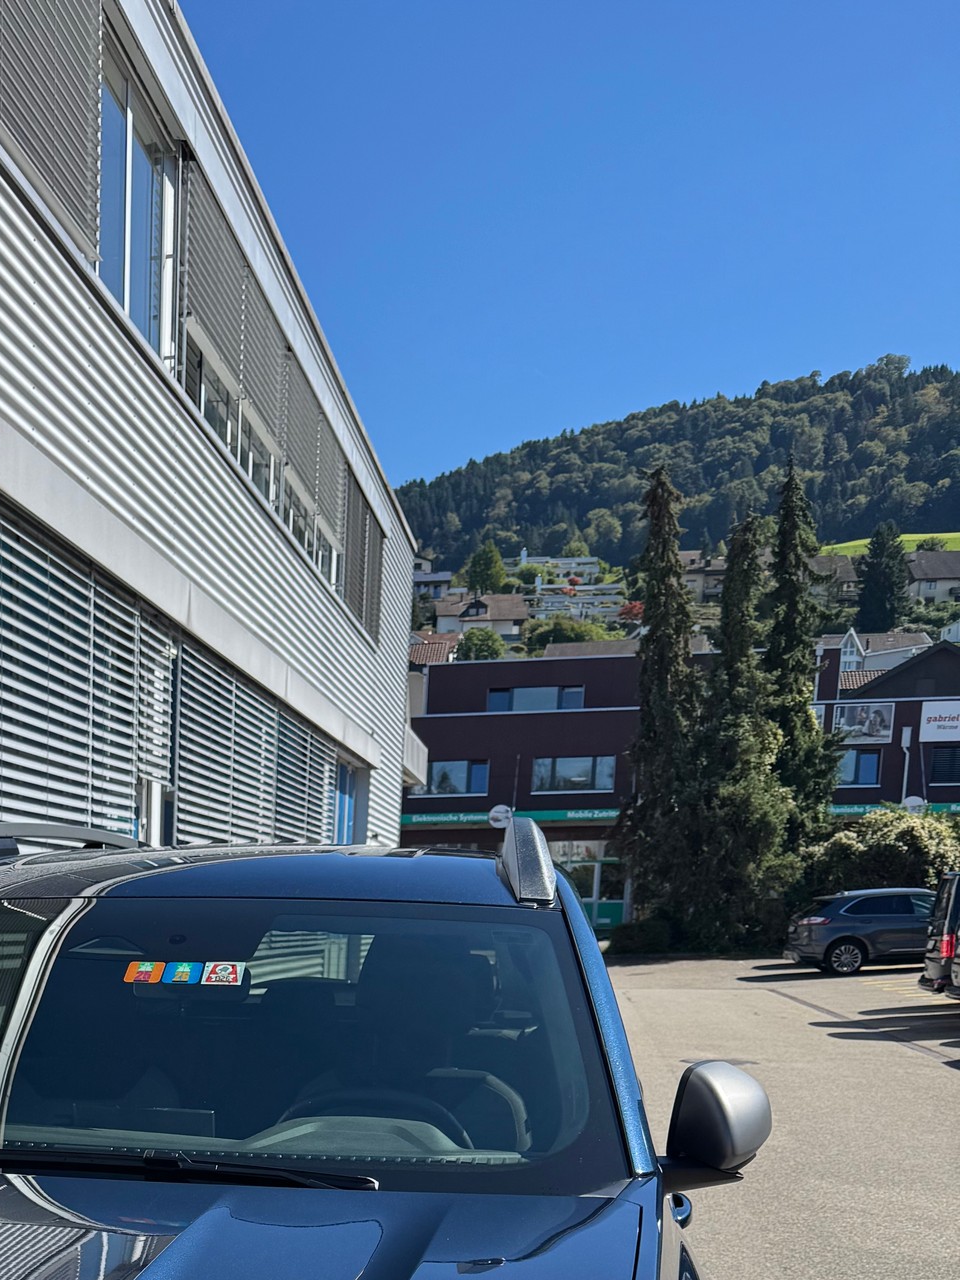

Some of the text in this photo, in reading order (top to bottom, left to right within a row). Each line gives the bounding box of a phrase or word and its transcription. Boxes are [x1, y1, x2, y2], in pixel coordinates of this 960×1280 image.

[926, 714, 960, 725] gabriel
[412, 814, 458, 823] Elektronische
[172, 971, 190, 982] 26
